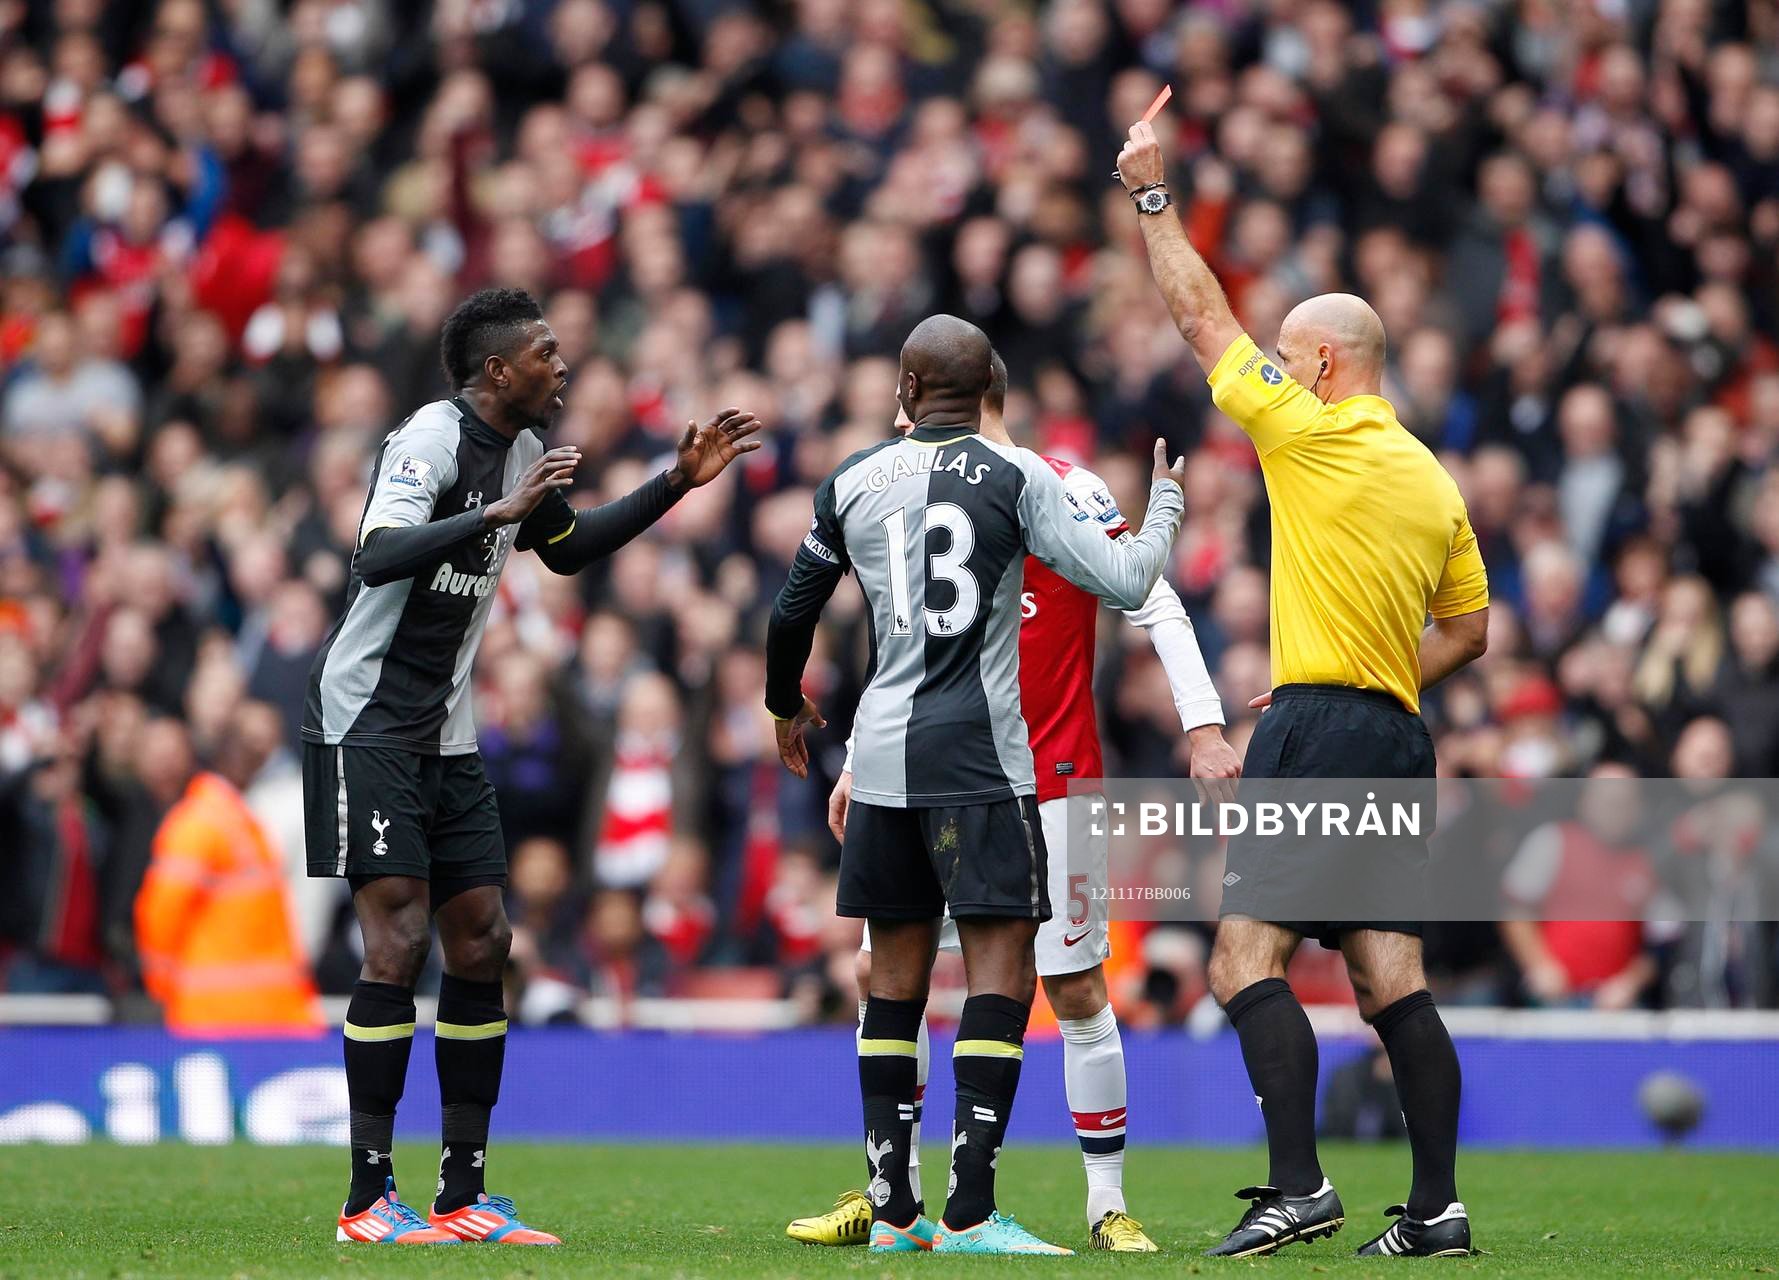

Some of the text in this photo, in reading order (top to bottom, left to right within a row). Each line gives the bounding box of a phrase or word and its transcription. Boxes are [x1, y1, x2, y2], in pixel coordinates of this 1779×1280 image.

[866, 450, 992, 493] GALLAS
[429, 562, 499, 598] Auras
[880, 501, 981, 637] 13
[1068, 873, 1091, 927] 5
